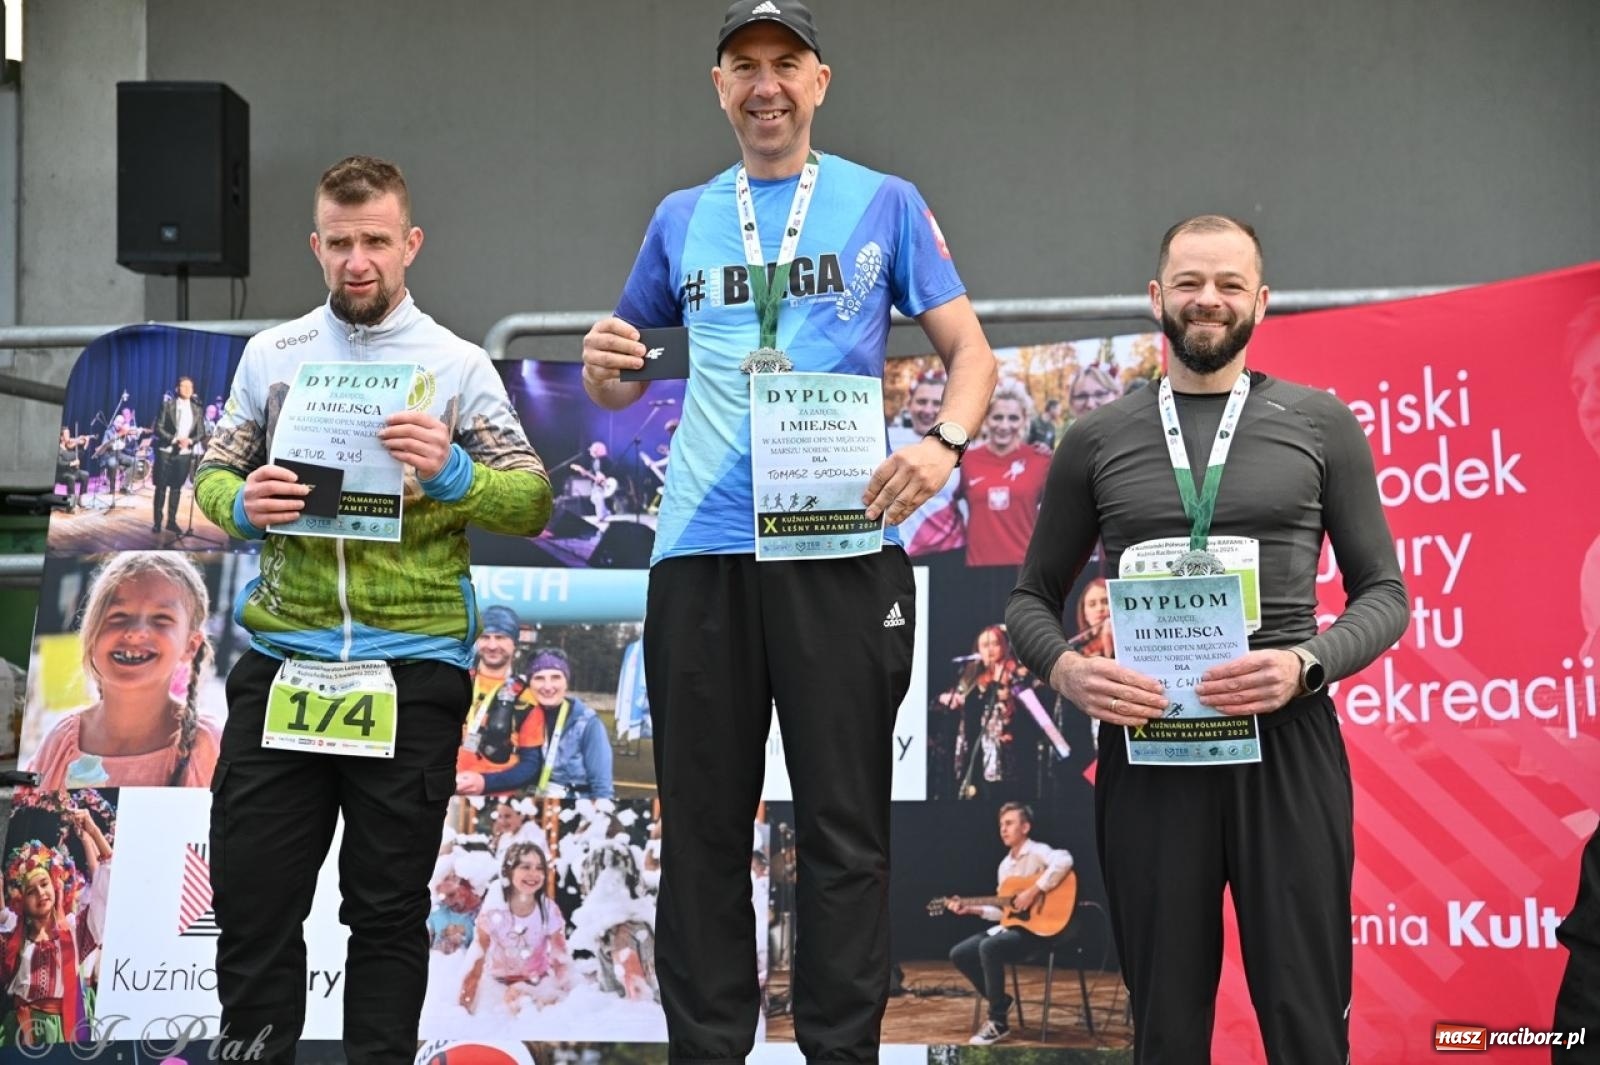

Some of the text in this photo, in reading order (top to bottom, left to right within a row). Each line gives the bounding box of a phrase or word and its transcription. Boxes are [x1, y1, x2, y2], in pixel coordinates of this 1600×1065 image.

[723, 253, 845, 306] BGA
[275, 328, 319, 350] deep
[305, 375, 400, 390] DYPLOM
[767, 389, 869, 405] DYPLOM
[306, 401, 382, 416] II MIEJSCA
[780, 420, 858, 432] I MIEJSCA
[330, 437, 346, 445] DLA
[767, 468, 808, 481] TOMASZ
[342, 495, 395, 505] PÓŁMARATON
[372, 506, 394, 514] 2025
[829, 513, 866, 522] PÓŁMARA
[763, 516, 779, 534] X
[1124, 592, 1228, 611] DYPLOM
[883, 617, 905, 628] adidas
[1135, 625, 1224, 640] III MIEJSCA
[1174, 643, 1194, 652] OPEN
[286, 690, 377, 737] 174
[1195, 719, 1249, 730] PÓŁMARATON
[1150, 728, 1249, 738] LEŚNY RAFAMET 2025
